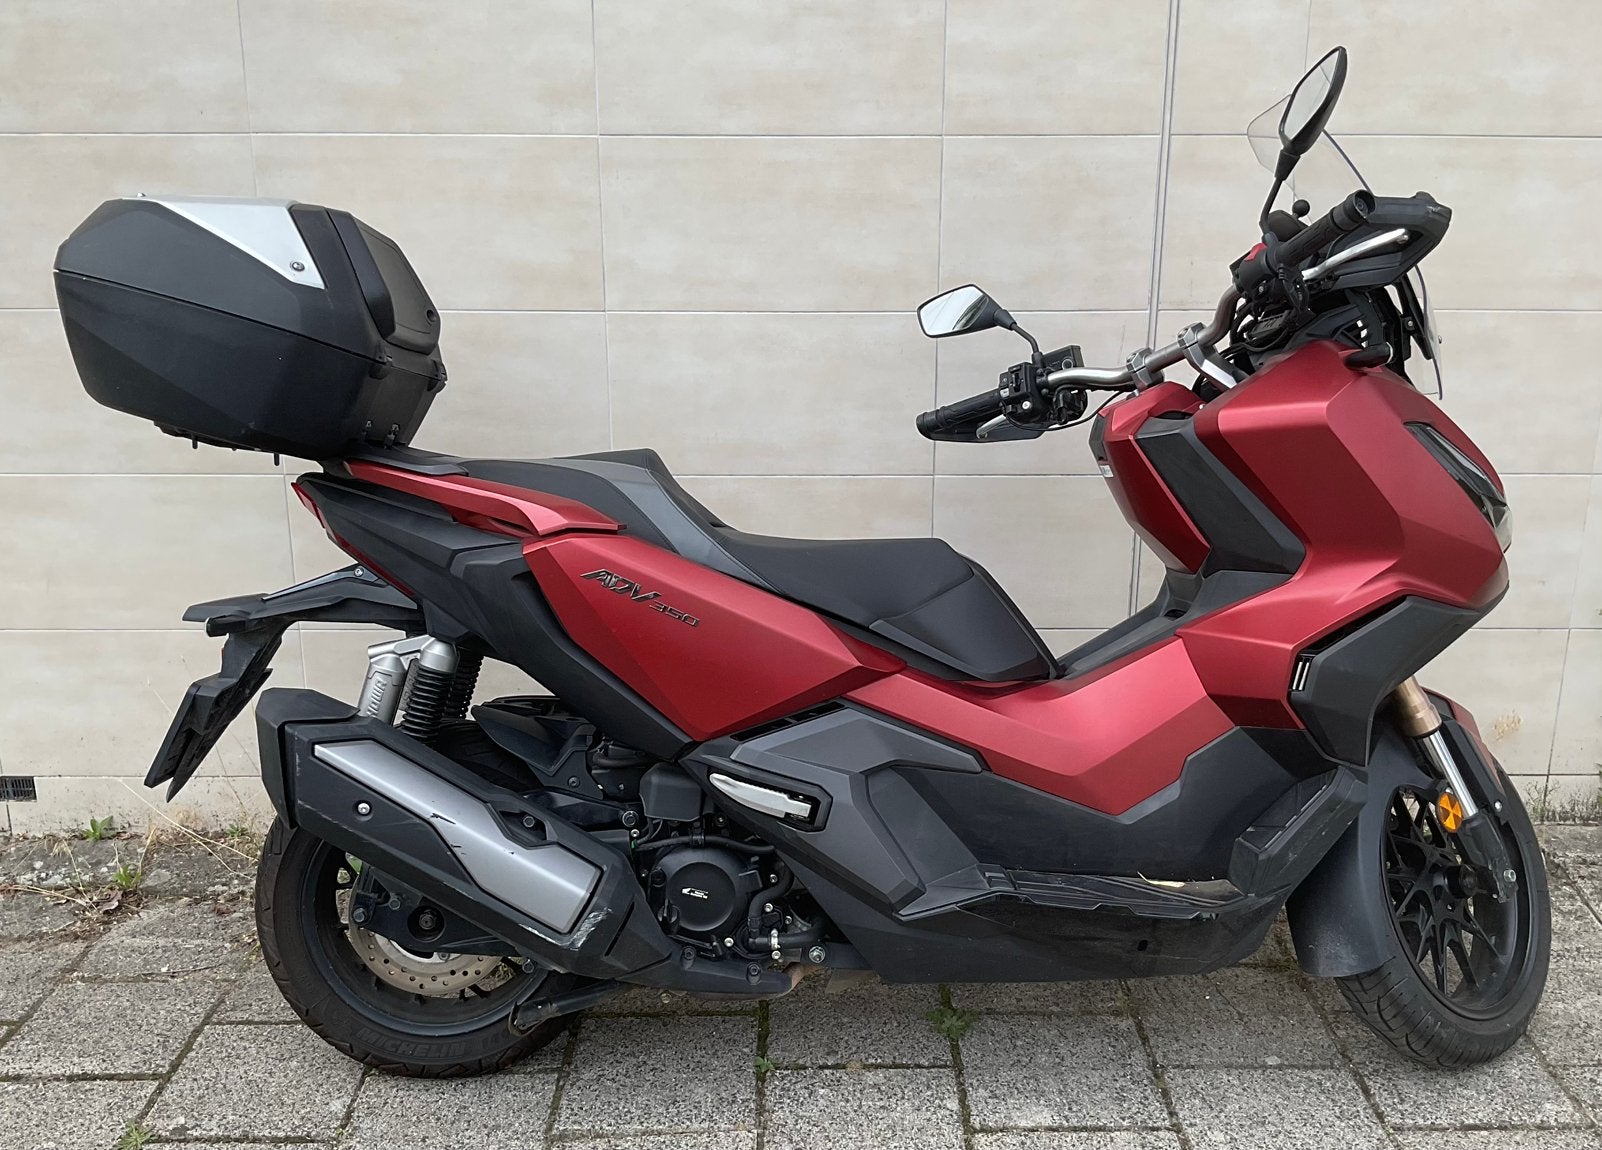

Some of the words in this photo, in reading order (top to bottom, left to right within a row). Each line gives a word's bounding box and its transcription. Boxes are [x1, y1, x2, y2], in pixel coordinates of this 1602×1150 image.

[580, 569, 661, 602] ADV
[648, 600, 700, 627] 350
[366, 677, 387, 717] HOWA
[356, 1027, 466, 1058] MICHELIN
